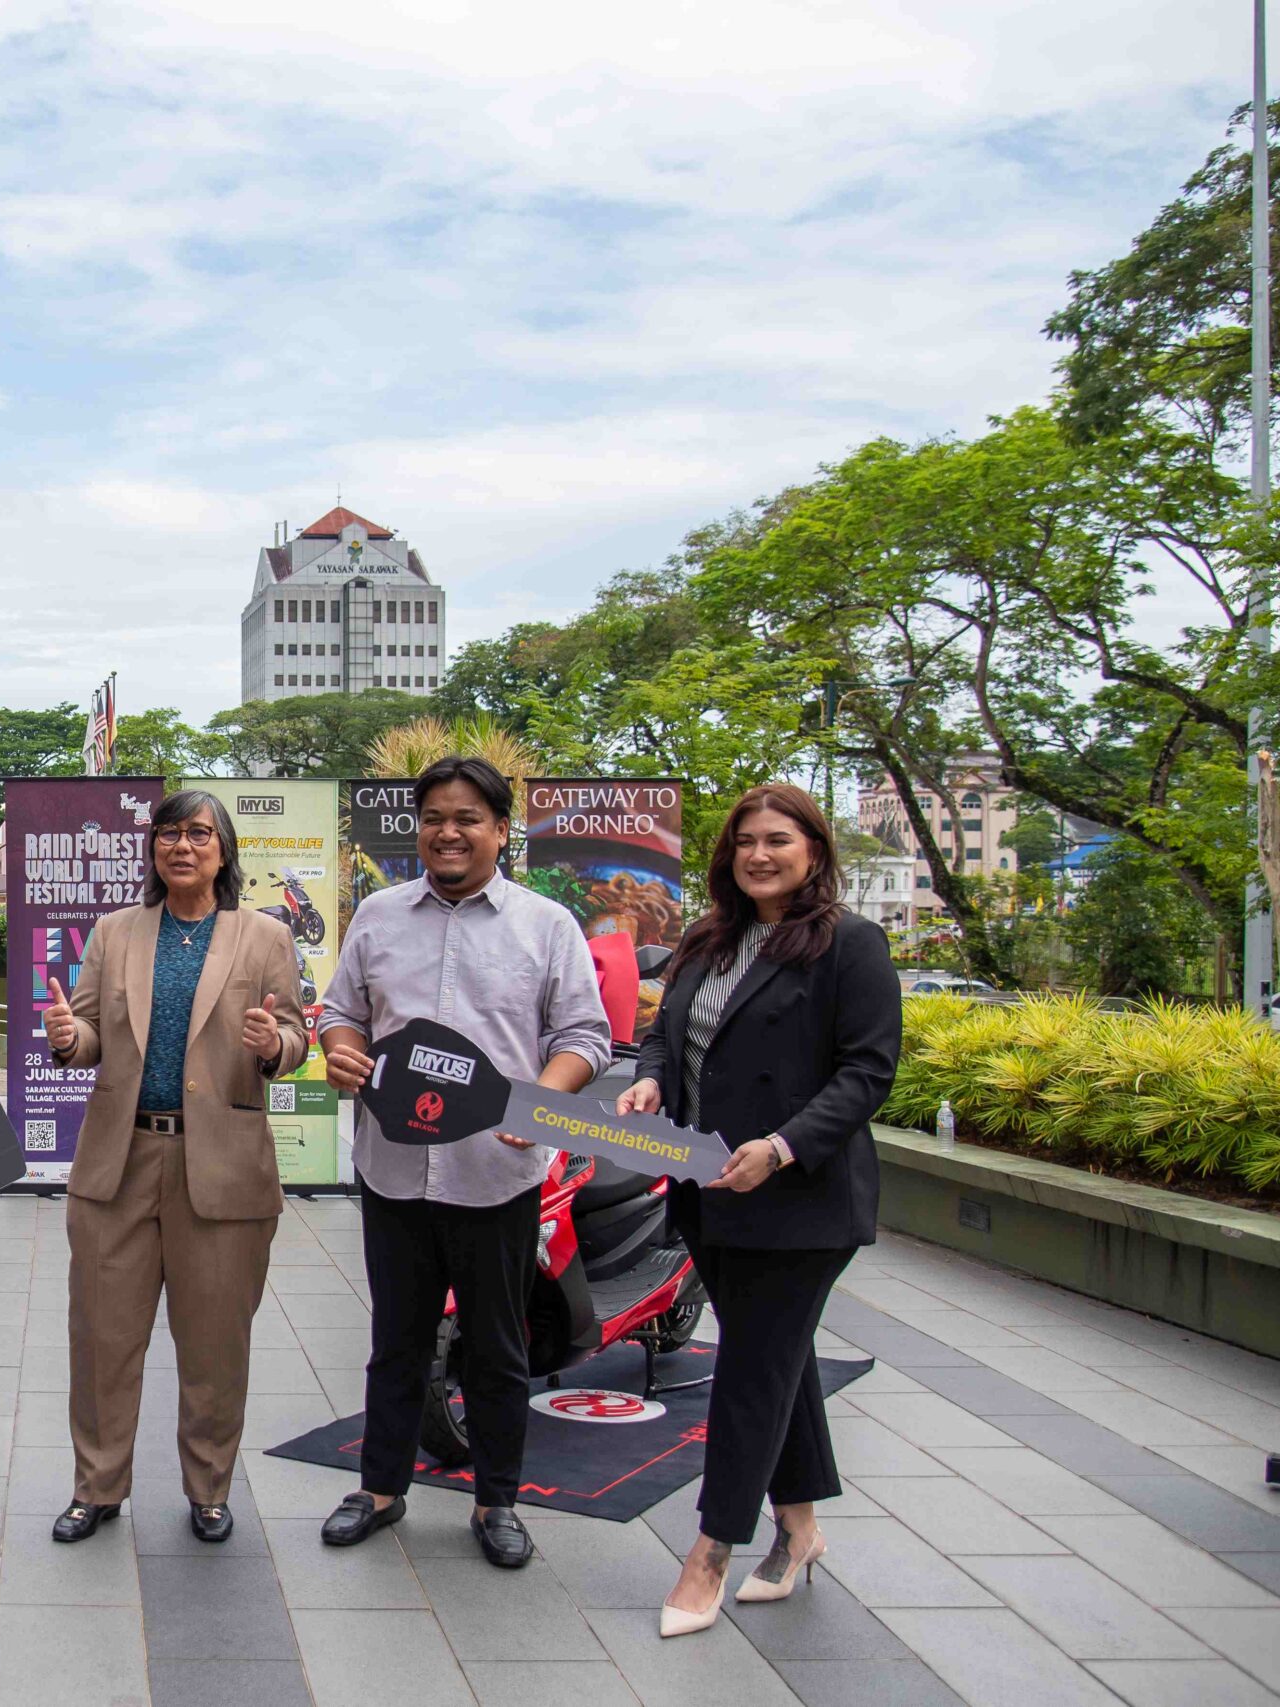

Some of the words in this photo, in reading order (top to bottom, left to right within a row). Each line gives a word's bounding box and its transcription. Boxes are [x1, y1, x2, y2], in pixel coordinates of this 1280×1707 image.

[317, 565, 354, 574] YAYASAN
[359, 565, 399, 574] SARAWAK
[355, 787, 416, 808] GATE
[532, 787, 639, 808] GATEWAY
[642, 787, 676, 808] TO
[236, 837, 261, 849] RIFY
[263, 837, 297, 849] YOUR
[297, 837, 324, 849] LIFE
[301, 851, 321, 859] Future
[25, 859, 84, 882] WORLD
[89, 859, 144, 882] MUSIC
[25, 882, 97, 905] FESTIVAL
[46, 912, 88, 920] CELEBRATES
[89, 912, 95, 920] A
[25, 1053, 42, 1066] 28
[413, 1050, 469, 1079] MYUS
[25, 1068, 64, 1081] JUNE
[66, 1068, 96, 1081] 202
[532, 1106, 691, 1164] Congratulations!
